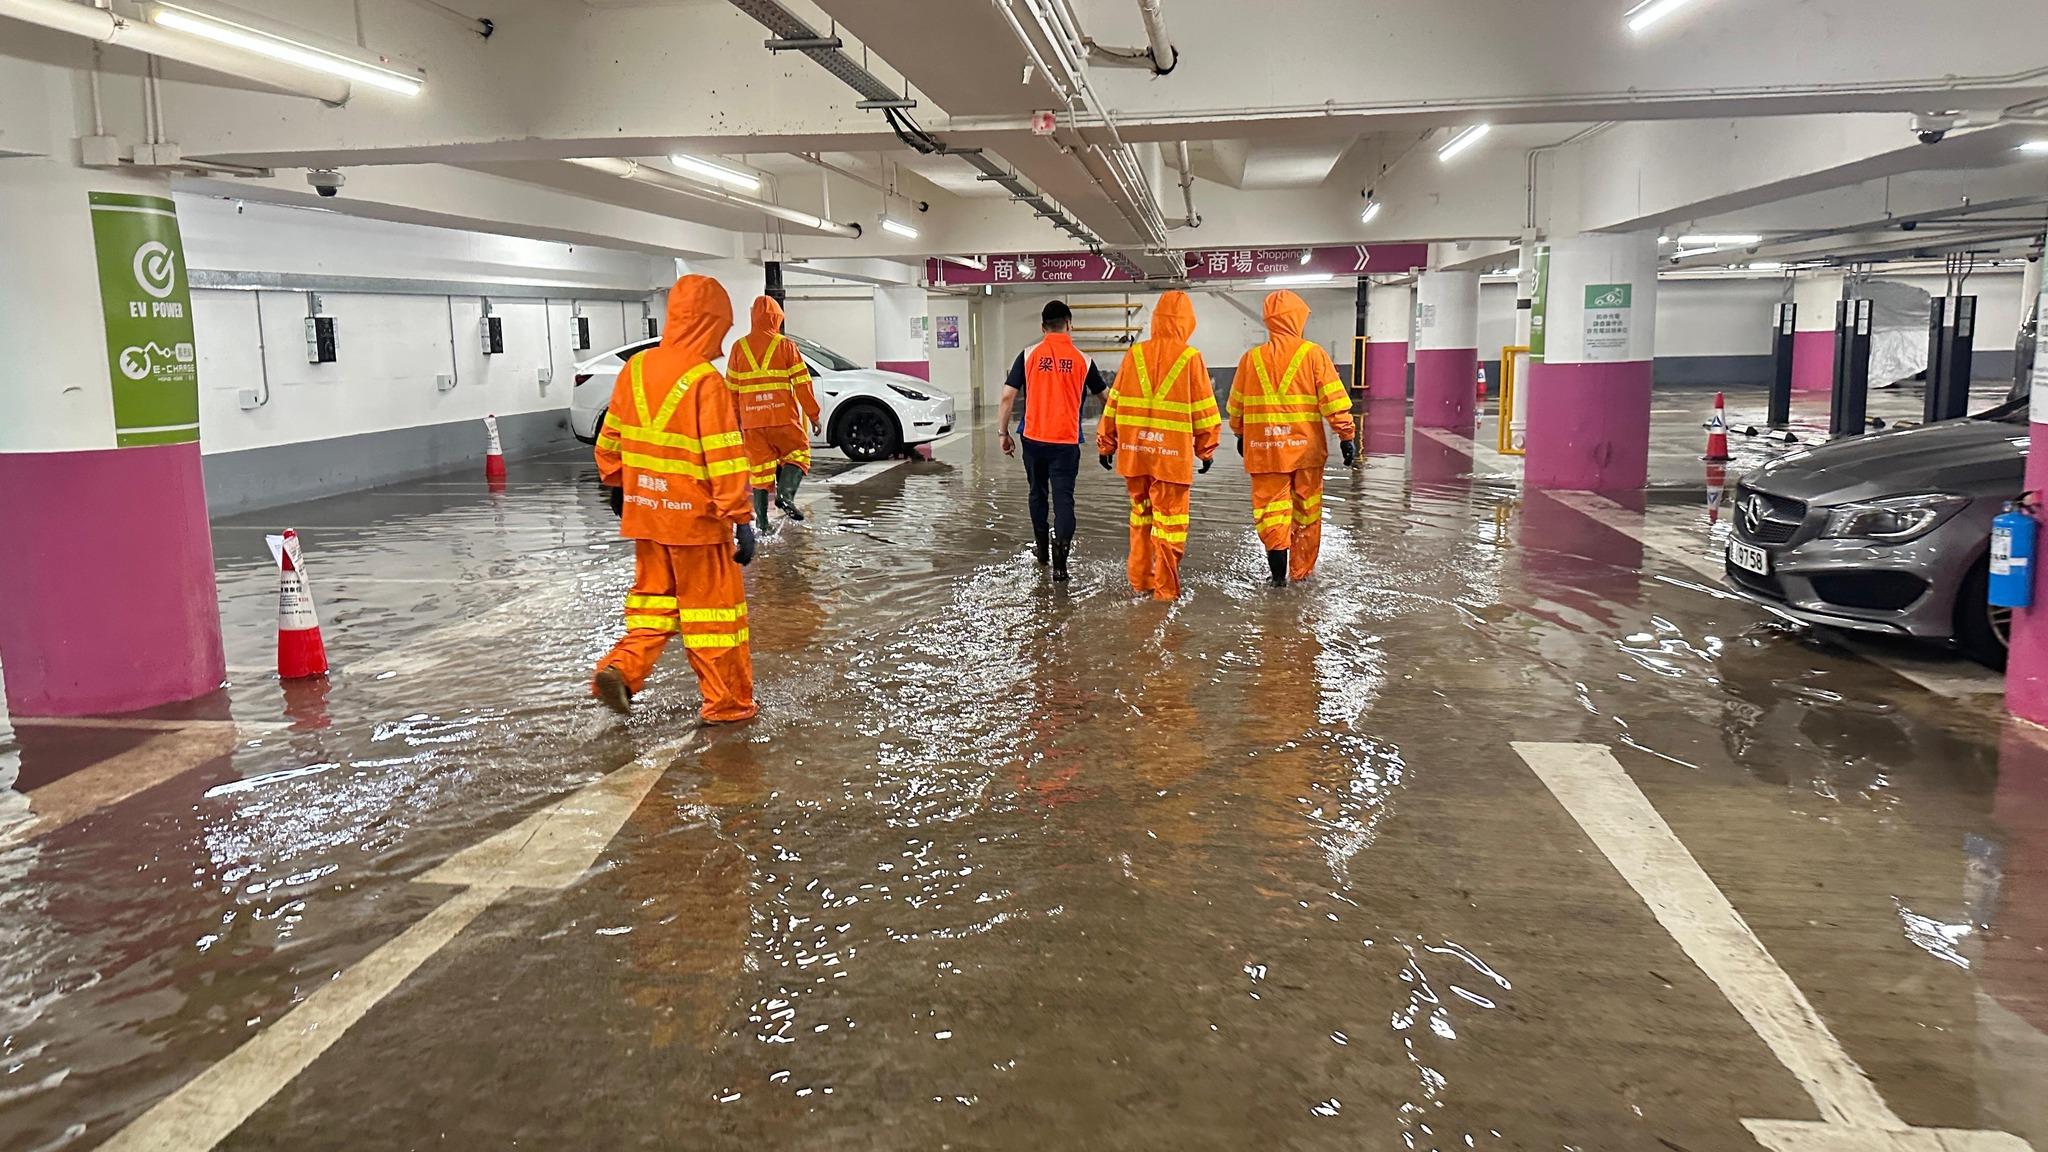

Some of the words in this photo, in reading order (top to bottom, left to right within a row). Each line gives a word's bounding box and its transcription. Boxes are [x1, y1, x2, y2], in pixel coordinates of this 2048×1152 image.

[1256, 249, 1302, 261] Shopping
[1042, 257, 1086, 269] Shopping
[1207, 250, 1253, 274] 商場
[1256, 262, 1289, 273] Centre
[1041, 270, 1073, 281] Centre
[129, 301, 147, 318] EV
[152, 302, 184, 318] POWER
[1287, 438, 1308, 447] Team
[1158, 446, 1179, 457] Team
[661, 498, 692, 511] Team
